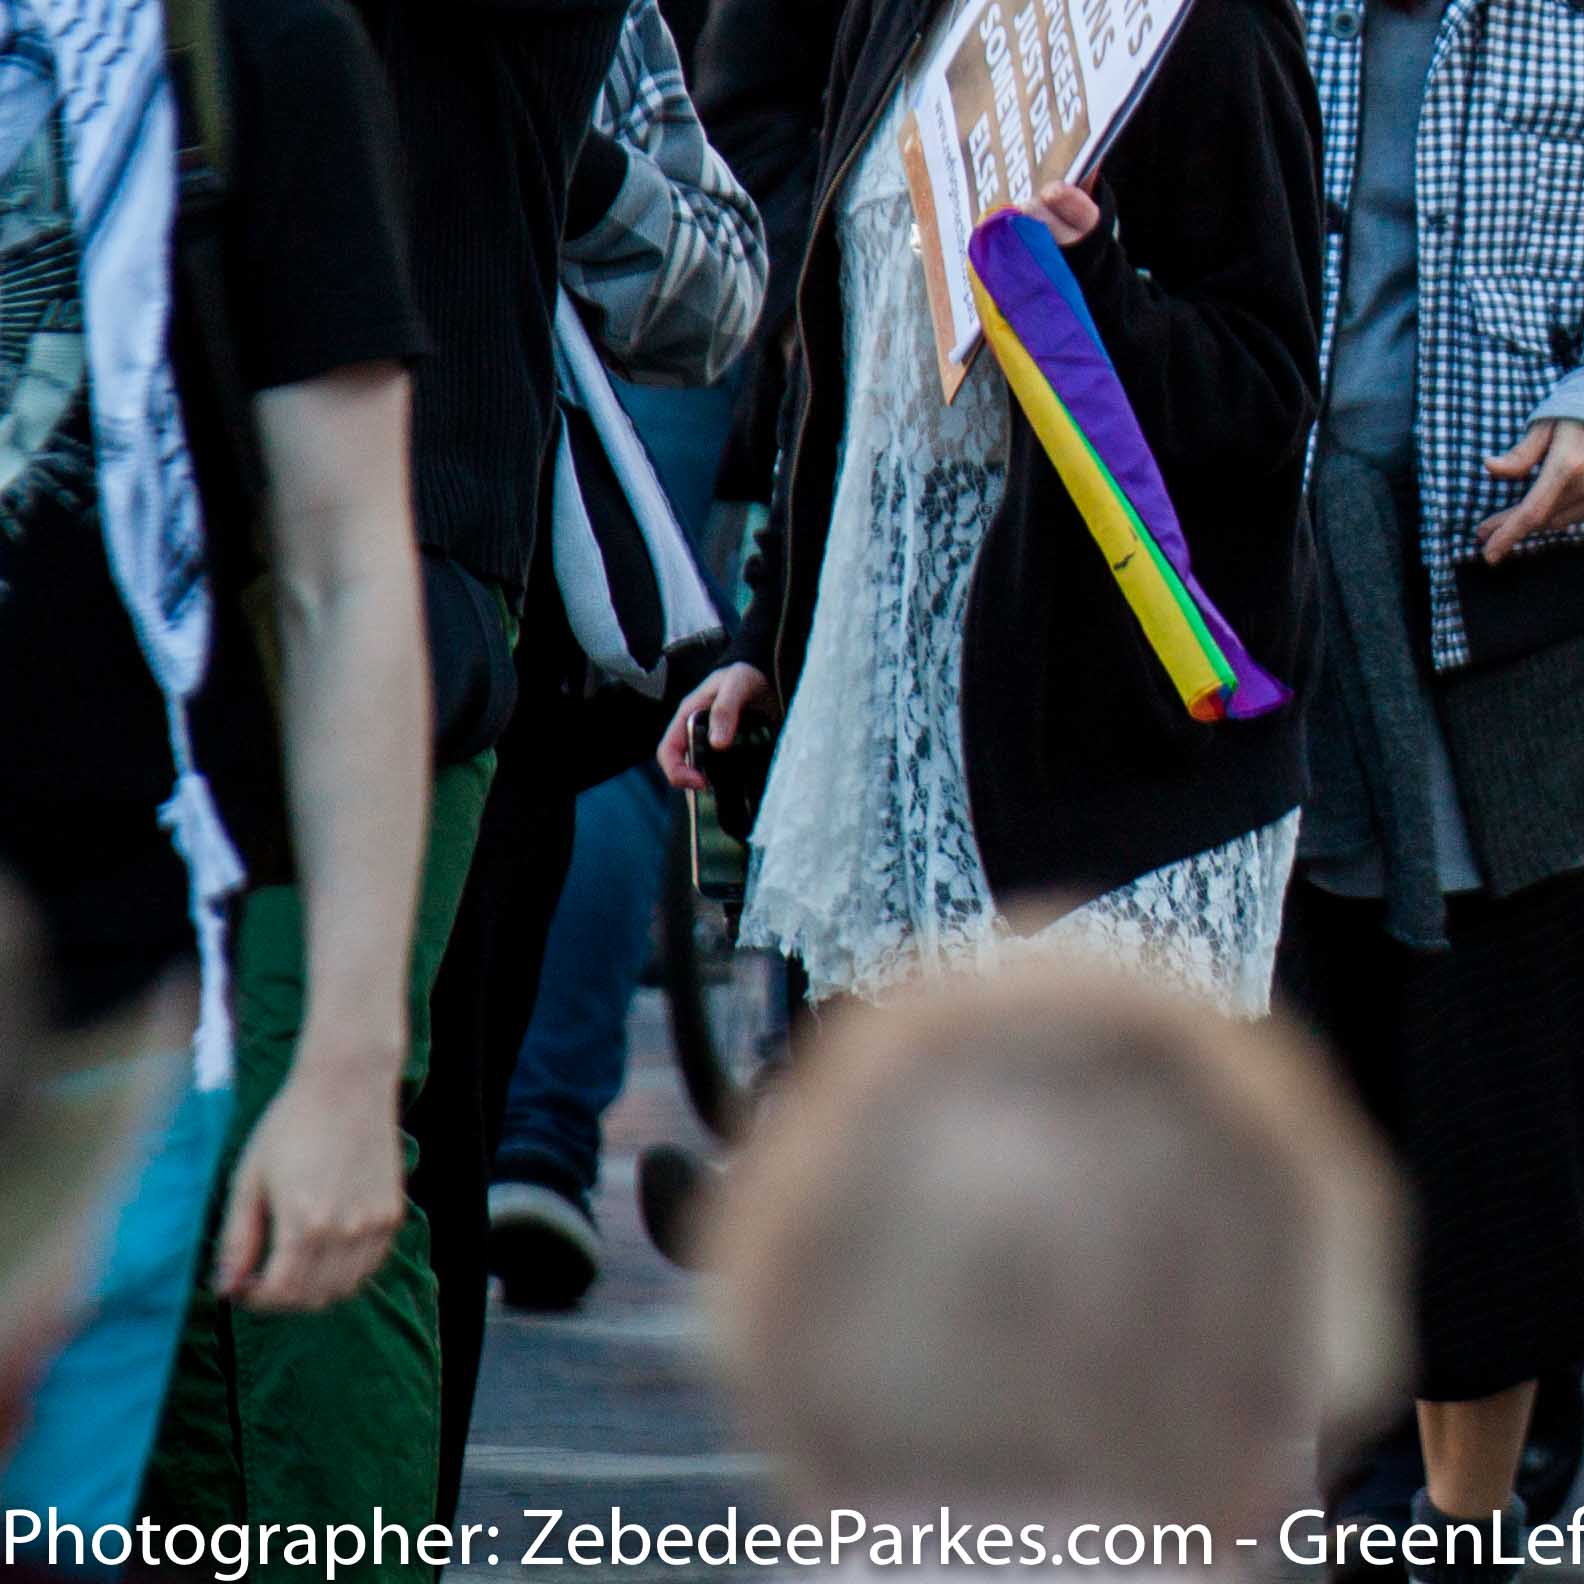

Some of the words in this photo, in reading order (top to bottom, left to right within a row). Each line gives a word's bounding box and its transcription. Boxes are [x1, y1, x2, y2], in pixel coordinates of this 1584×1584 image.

[968, 111, 999, 218] ELSE
[979, 2, 1033, 206] SOMEWHER
[1013, 0, 1045, 96] JUST
[1029, 83, 1054, 167] DIE
